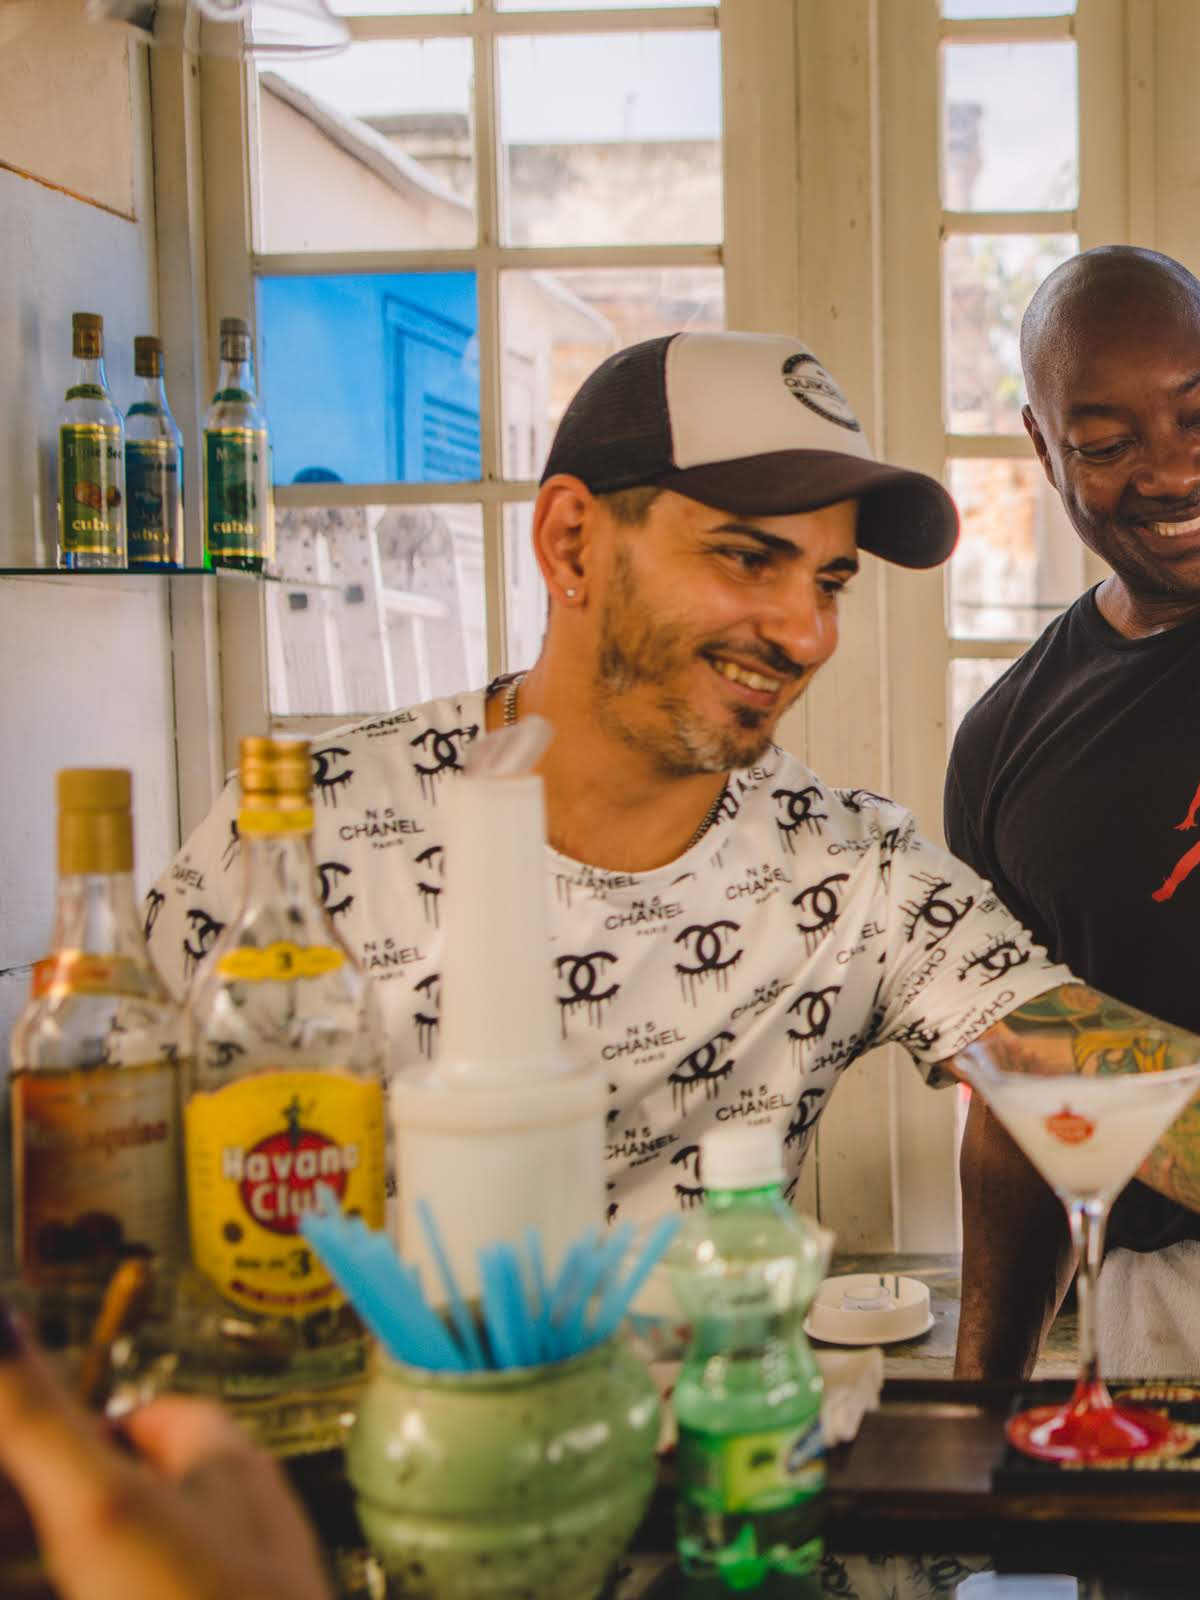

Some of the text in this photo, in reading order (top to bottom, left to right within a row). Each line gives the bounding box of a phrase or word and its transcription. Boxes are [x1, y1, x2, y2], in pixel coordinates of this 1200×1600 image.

[339, 819, 424, 841] CHANEL
[726, 867, 793, 901] CHANEL
[604, 903, 685, 931] CHANEL
[601, 1028, 686, 1061] CHANEL
[715, 1093, 793, 1122] CHANEL
[222, 1143, 360, 1182] Havana
